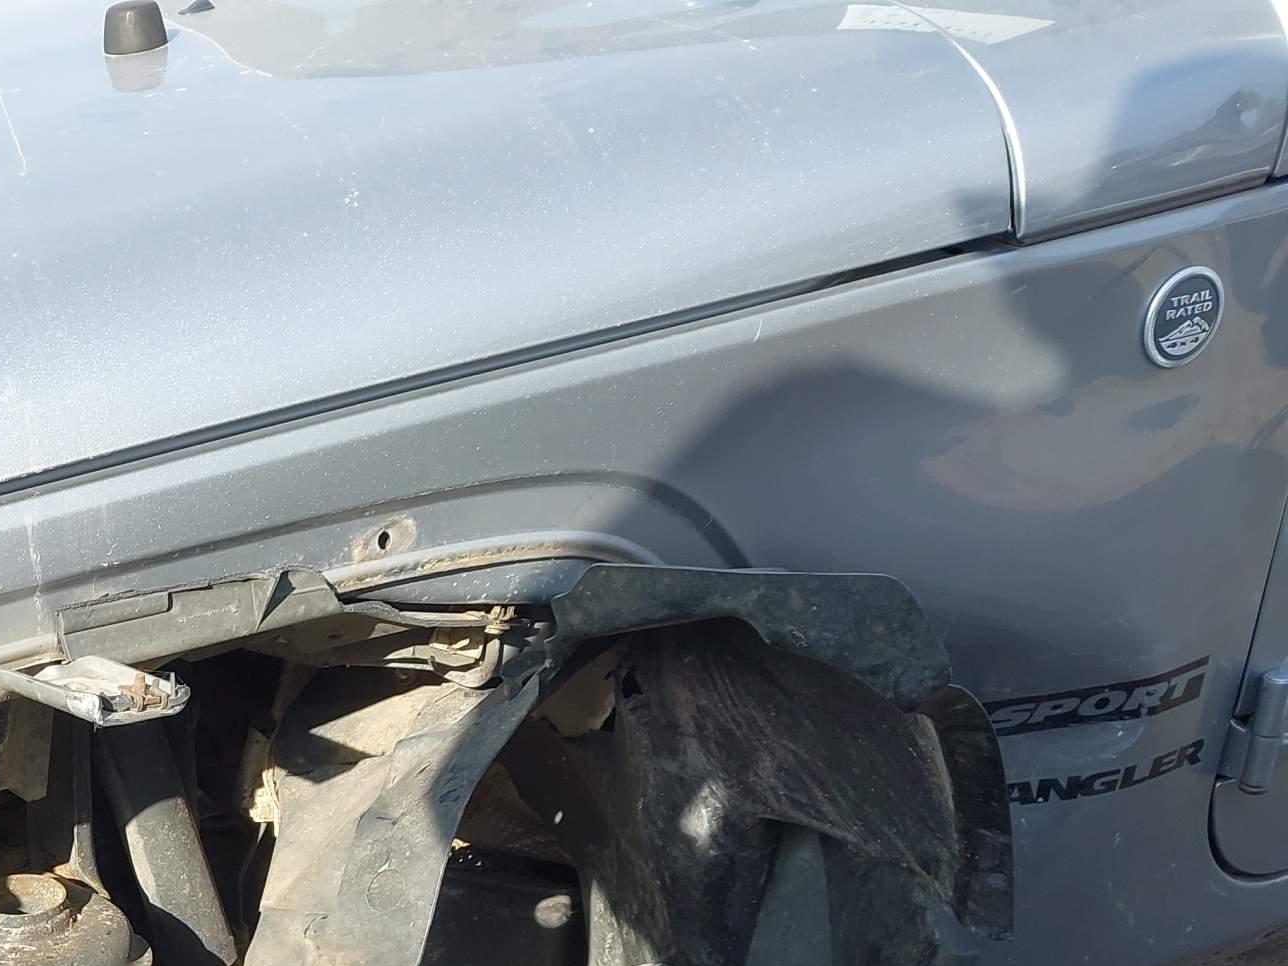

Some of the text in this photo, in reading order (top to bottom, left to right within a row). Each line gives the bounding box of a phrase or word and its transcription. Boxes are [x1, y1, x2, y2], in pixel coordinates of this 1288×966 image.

[1165, 301, 1213, 321] RATED
[1170, 289, 1213, 308] TRAIL
[987, 664, 1208, 731] SPORT
[1008, 738, 1205, 806] ANGLER
